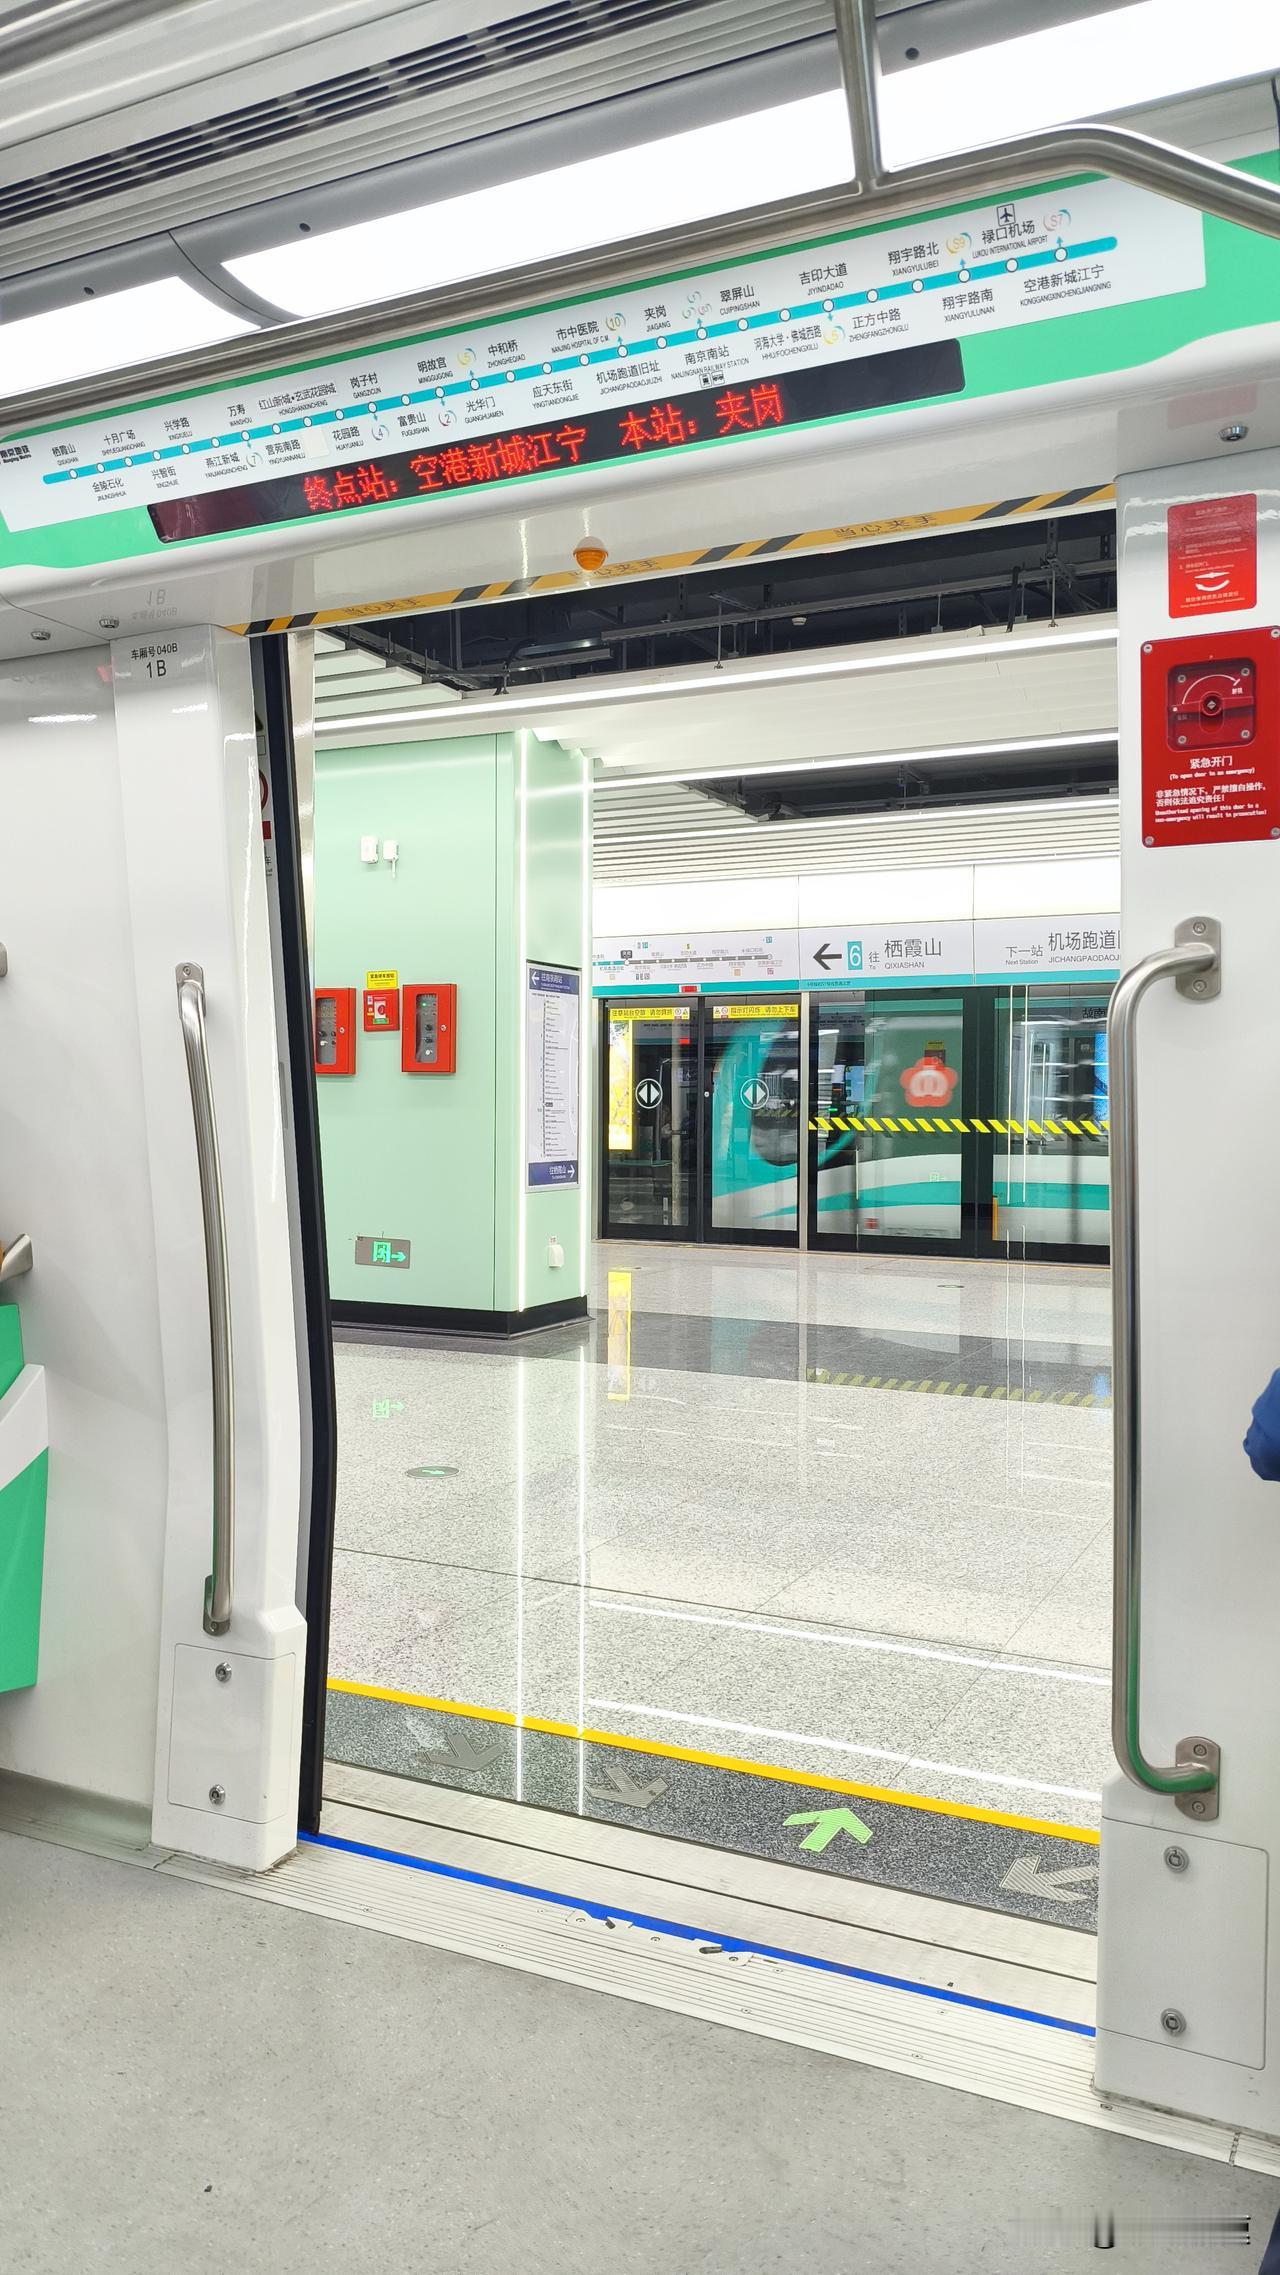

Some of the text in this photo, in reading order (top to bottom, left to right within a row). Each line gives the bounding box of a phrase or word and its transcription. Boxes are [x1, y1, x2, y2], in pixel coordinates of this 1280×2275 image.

[981, 220, 1035, 244] 禄口机场
[888, 242, 939, 265] 翔宇路北
[972, 235, 1048, 259] LUKOU INTERNATIONAL AIRPORT
[799, 263, 848, 286] 吉印大道
[892, 260, 939, 277] XIANGYULUBEI
[1023, 264, 1104, 293] 空港新城江宁
[720, 284, 755, 303] 翠屏山
[807, 281, 844, 296] JIYINDADAO
[1020, 281, 1111, 307] KONGGANGXINCHENGJIANGNING
[942, 288, 993, 311] 翔宇路南
[644, 305, 667, 321] 夹岗
[719, 301, 760, 316] CUIPINGSHAN
[944, 305, 995, 323] XIANGYULUNAN
[646, 320, 671, 333] JIAGANG
[852, 308, 901, 330] 正方中路
[556, 321, 600, 341] 市中医院
[849, 323, 910, 343] ZHENGFANGZHONGLU
[487, 339, 519, 357] 中和桥
[571, 338, 592, 350] HOSPITAL
[593, 337, 600, 345] OF
[487, 354, 526, 369] ZHONGHEQIAO
[685, 345, 730, 365] 南京南站
[417, 357, 447, 374] 明故宫
[596, 360, 661, 384] 机场跑道旧址
[703, 362, 726, 374] RAILWAY
[727, 357, 750, 369] STATION
[350, 372, 378, 389] 岗子村
[418, 371, 453, 384] MINGGUGONG
[600, 376, 662, 396] JICHANGPAODAOJIUZHI
[353, 387, 382, 400] GANGZICUN
[532, 379, 573, 398] 应天东街
[466, 396, 496, 413] 光华门
[532, 394, 580, 409] YINGTIANDONGJIE
[227, 404, 246, 417] 万寿
[464, 410, 504, 424] GUANGHUAMEN
[164, 417, 190, 431] 兴学路
[230, 417, 253, 427] WANSHOU
[397, 412, 427, 427] 富贵山
[103, 429, 136, 445] 十月广场
[332, 426, 361, 441] 花园路
[401, 426, 430, 438] FUGUISHAN
[409, 424, 587, 491] 空港新城江宁
[714, 383, 784, 434] 夹岗
[52, 443, 76, 457] 栖霞山
[265, 439, 301, 456] 营苑南路
[205, 452, 240, 469] 燕江新城
[151, 466, 176, 480] 兴智街
[92, 477, 124, 493] 金陵石化
[146, 659, 167, 680] 1B
[1190, 756, 1233, 770] 紧急开门
[884, 938, 942, 958] 栖霞山
[1048, 929, 1120, 952] 机场跑道
[849, 943, 862, 967] 6
[869, 951, 880, 963] 往
[1005, 945, 1043, 958] 下一站
[884, 961, 925, 970] QIXIASHAN
